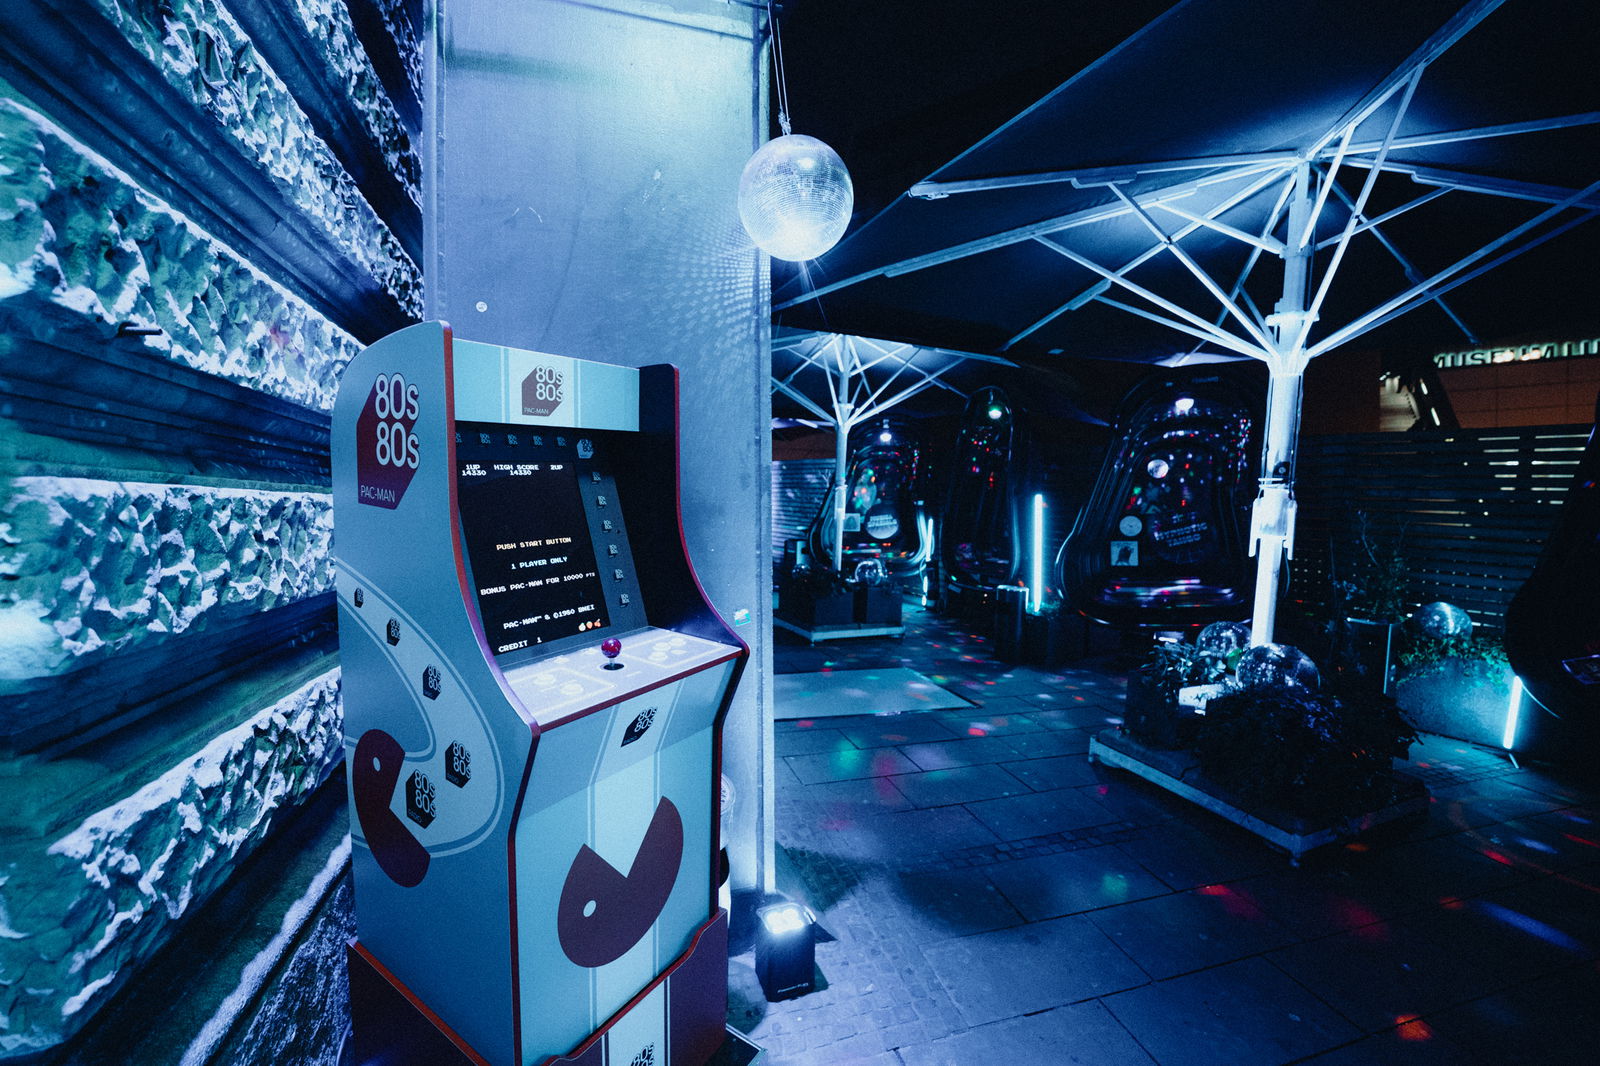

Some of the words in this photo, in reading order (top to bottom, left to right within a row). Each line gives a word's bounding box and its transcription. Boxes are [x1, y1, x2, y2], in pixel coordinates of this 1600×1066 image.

[536, 365, 563, 385] 80s
[375, 373, 419, 421] 80s
[536, 383, 563, 402] 80s
[524, 407, 549, 416] PAC-MAN
[376, 421, 420, 469] 80s
[360, 484, 396, 503] PAC-MAN
[496, 542, 516, 551] PUSH
[520, 540, 542, 548] START
[546, 537, 571, 545] BUTTON
[519, 559, 547, 569] PLAYER
[550, 556, 568, 564] ONLY
[480, 585, 506, 596] BONUS
[510, 579, 543, 591] PAC-MAN
[546, 577, 560, 585] FOR
[563, 573, 583, 582] 10000
[498, 640, 528, 653] CREDIT
[453, 741, 471, 763] 80s
[453, 756, 471, 779] 80s
[415, 770, 435, 799] 80s
[415, 789, 437, 818] 80s
